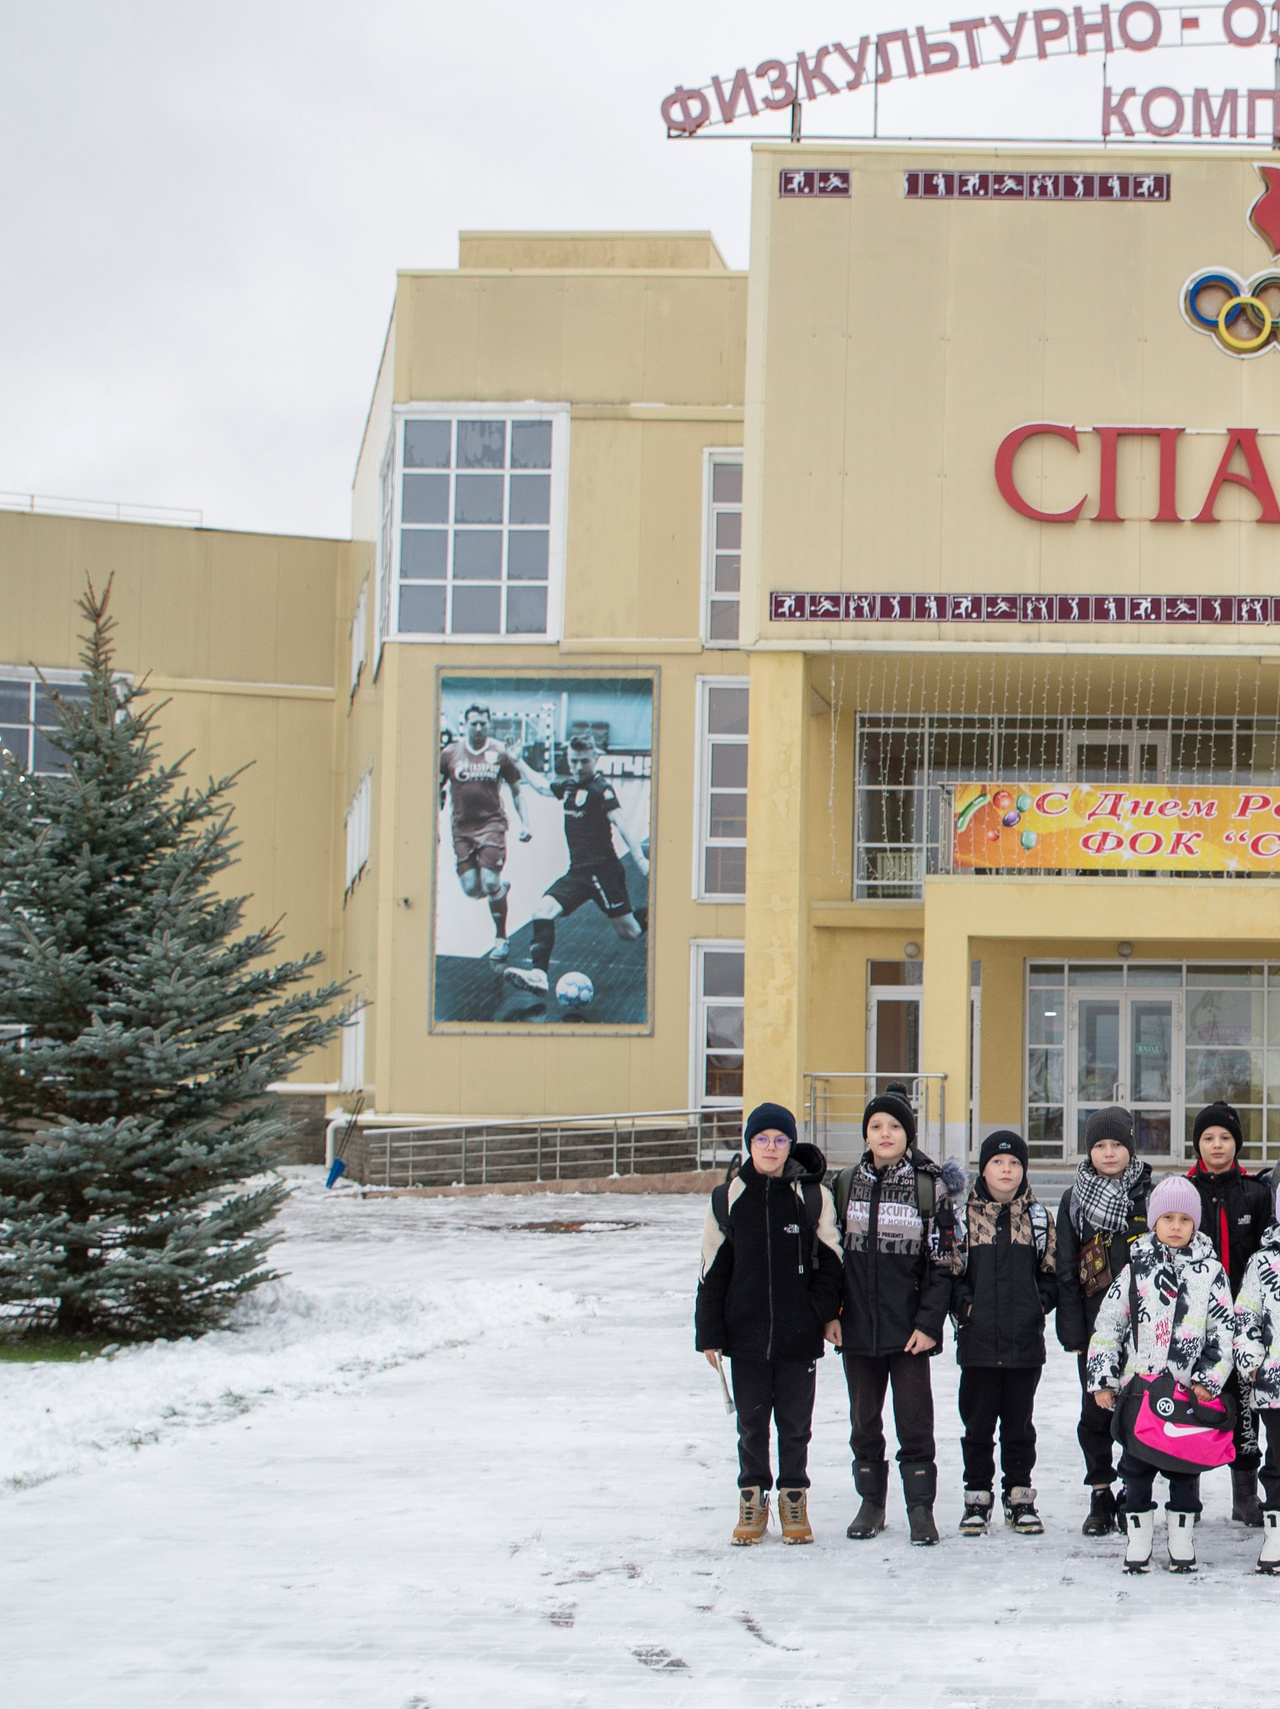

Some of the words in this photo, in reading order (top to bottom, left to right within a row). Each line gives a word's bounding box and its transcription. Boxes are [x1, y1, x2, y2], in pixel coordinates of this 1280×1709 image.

[660, 1, 1162, 136] ФИЗКУЛЬТУРНО
[1035, 792, 1069, 815] С
[1087, 793, 1217, 822] Днем
[1080, 831, 1202, 856] ФОК
[1160, 1401, 1172, 1412] 90
